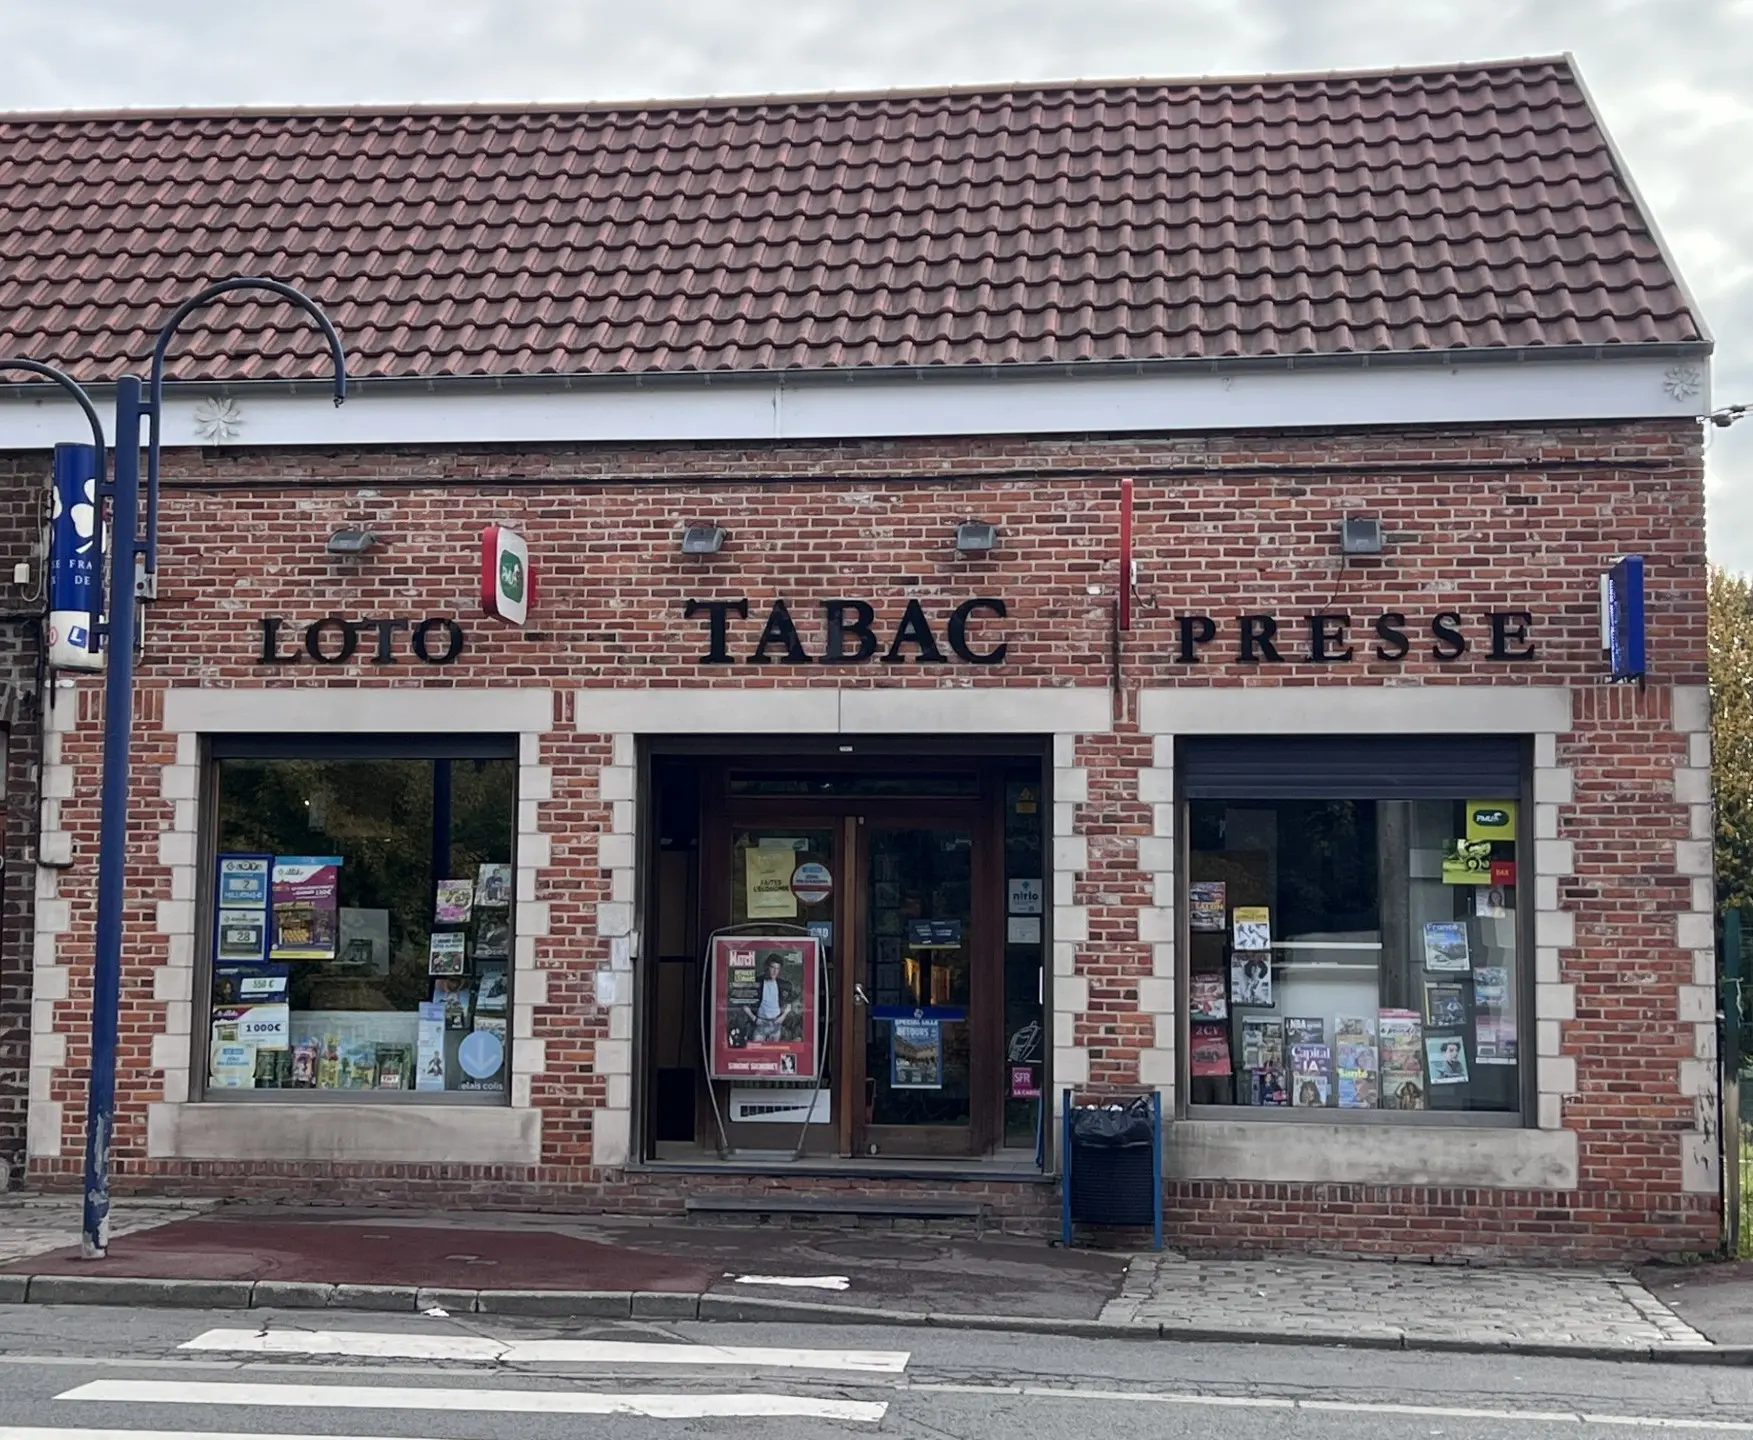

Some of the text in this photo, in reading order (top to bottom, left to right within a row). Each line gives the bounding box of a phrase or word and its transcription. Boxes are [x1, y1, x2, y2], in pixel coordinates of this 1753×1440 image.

[684, 598, 1007, 664] TABAC
[1174, 611, 1535, 663] PRESSE
[258, 618, 464, 664] LOTO
[243, 880, 250, 889] 2
[237, 932, 251, 941] 28
[1291, 1045, 1331, 1059] Capital
[1303, 1060, 1319, 1072] IA
[1014, 1072, 1031, 1083] SFR
